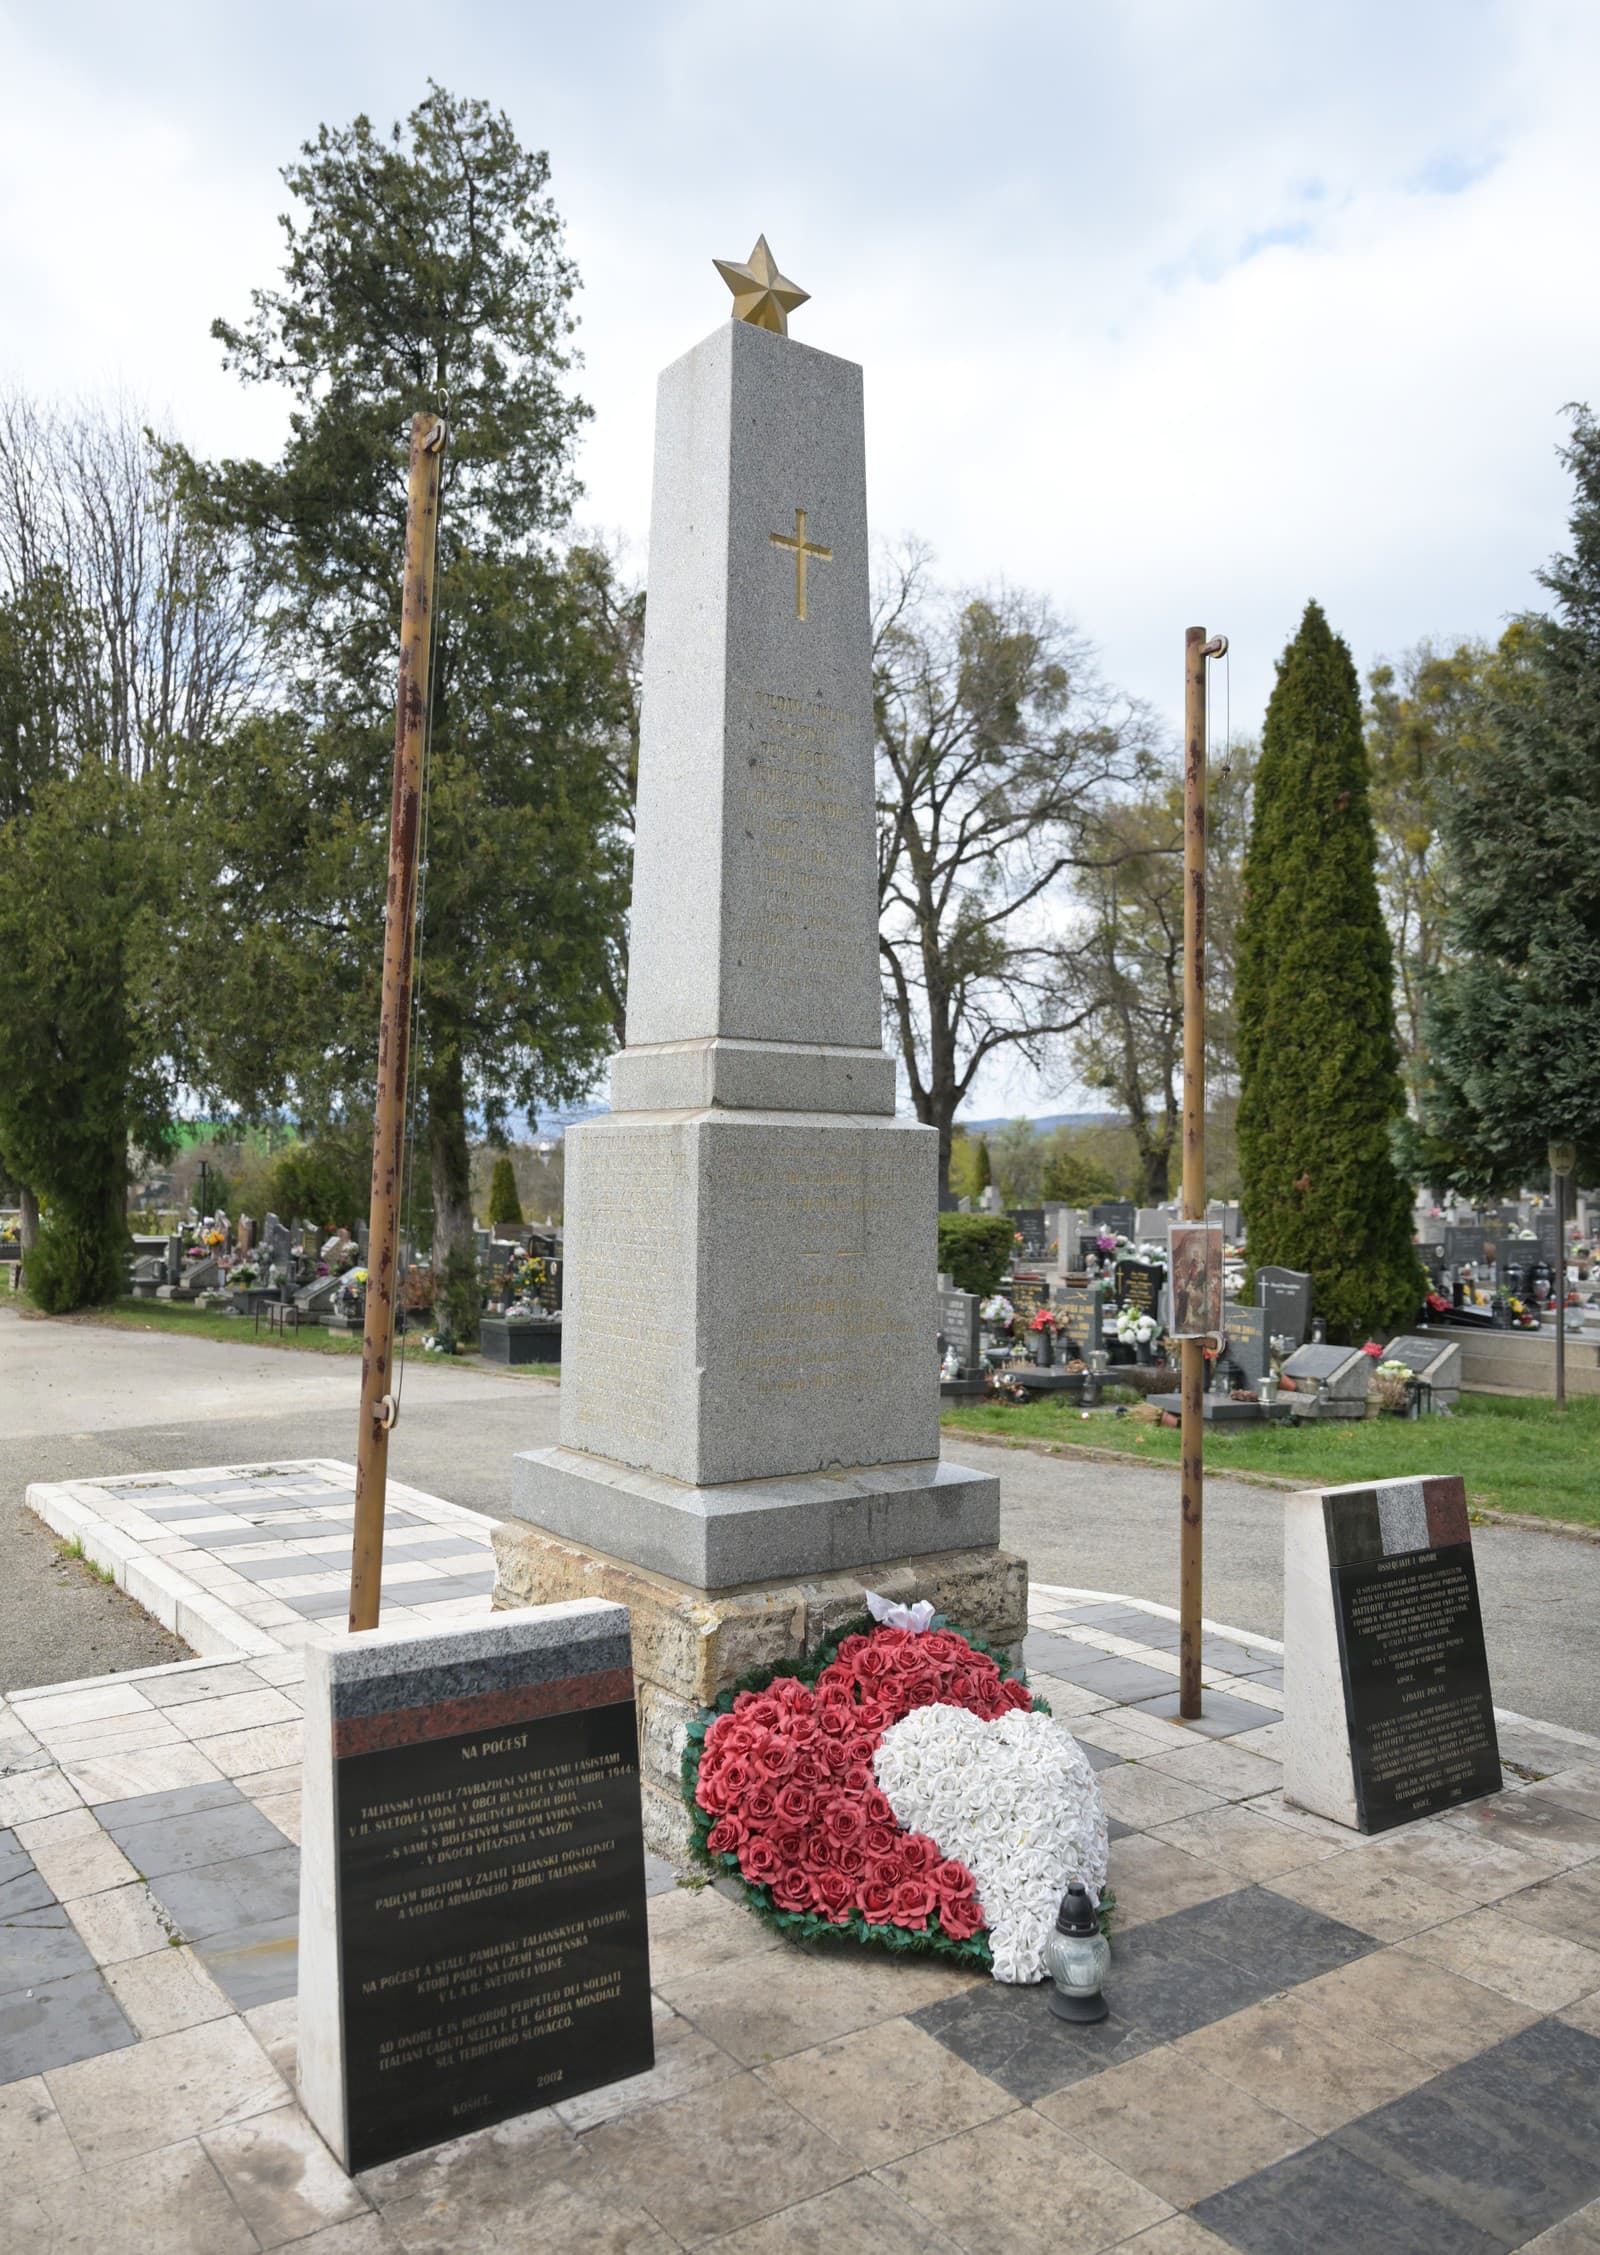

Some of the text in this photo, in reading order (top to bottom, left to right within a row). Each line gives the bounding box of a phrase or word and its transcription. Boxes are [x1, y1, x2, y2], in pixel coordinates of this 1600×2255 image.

[461, 1744, 478, 1761] NA
[349, 1827, 355, 1838] V
[374, 1811, 424, 1832] SVETOVEJ
[462, 1801, 468, 1812] V
[471, 1795, 495, 1810] OBCI
[548, 1782, 553, 1792] V
[557, 1771, 604, 1790] NOVEMBRI
[403, 1841, 427, 1856] VAMI
[503, 1814, 542, 1832] SRDCOM
[421, 1826, 427, 1836] S
[431, 1819, 455, 1834] VAMI
[458, 1817, 465, 1828] V
[426, 1854, 435, 1866] V
[529, 1830, 535, 1841] A
[398, 1908, 405, 1921] A
[408, 1898, 444, 1918] VOJACI
[511, 1872, 544, 1891] ZBORU
[420, 1879, 462, 1899] BRATOM
[465, 1876, 473, 1888] V
[486, 1961, 499, 1974] NA
[535, 1935, 588, 1960] SLOVENSKA
[362, 1980, 376, 1995] NA
[423, 1964, 431, 1977] A
[439, 1992, 445, 2004] V
[460, 1986, 467, 1997] A
[484, 1966, 531, 1990] SVETOVEJ
[379, 2041, 394, 2056] AD
[398, 2029, 432, 2050] ONORE
[462, 2006, 507, 2030] RICORDO
[510, 1989, 560, 2014] PERPETUO
[563, 1983, 580, 1998] DEI
[583, 1970, 621, 1992] SOLDATI
[379, 2048, 422, 2072] ITALIANI
[426, 2035, 463, 2057] CADUTI
[467, 2024, 497, 2044] NELLA
[534, 2000, 572, 2022] GUERRA
[575, 1985, 621, 2009] MONDIALE
[435, 2014, 574, 2069] SUL TERRITORIO SLOVACCO.
[536, 2068, 563, 2088] 2002
